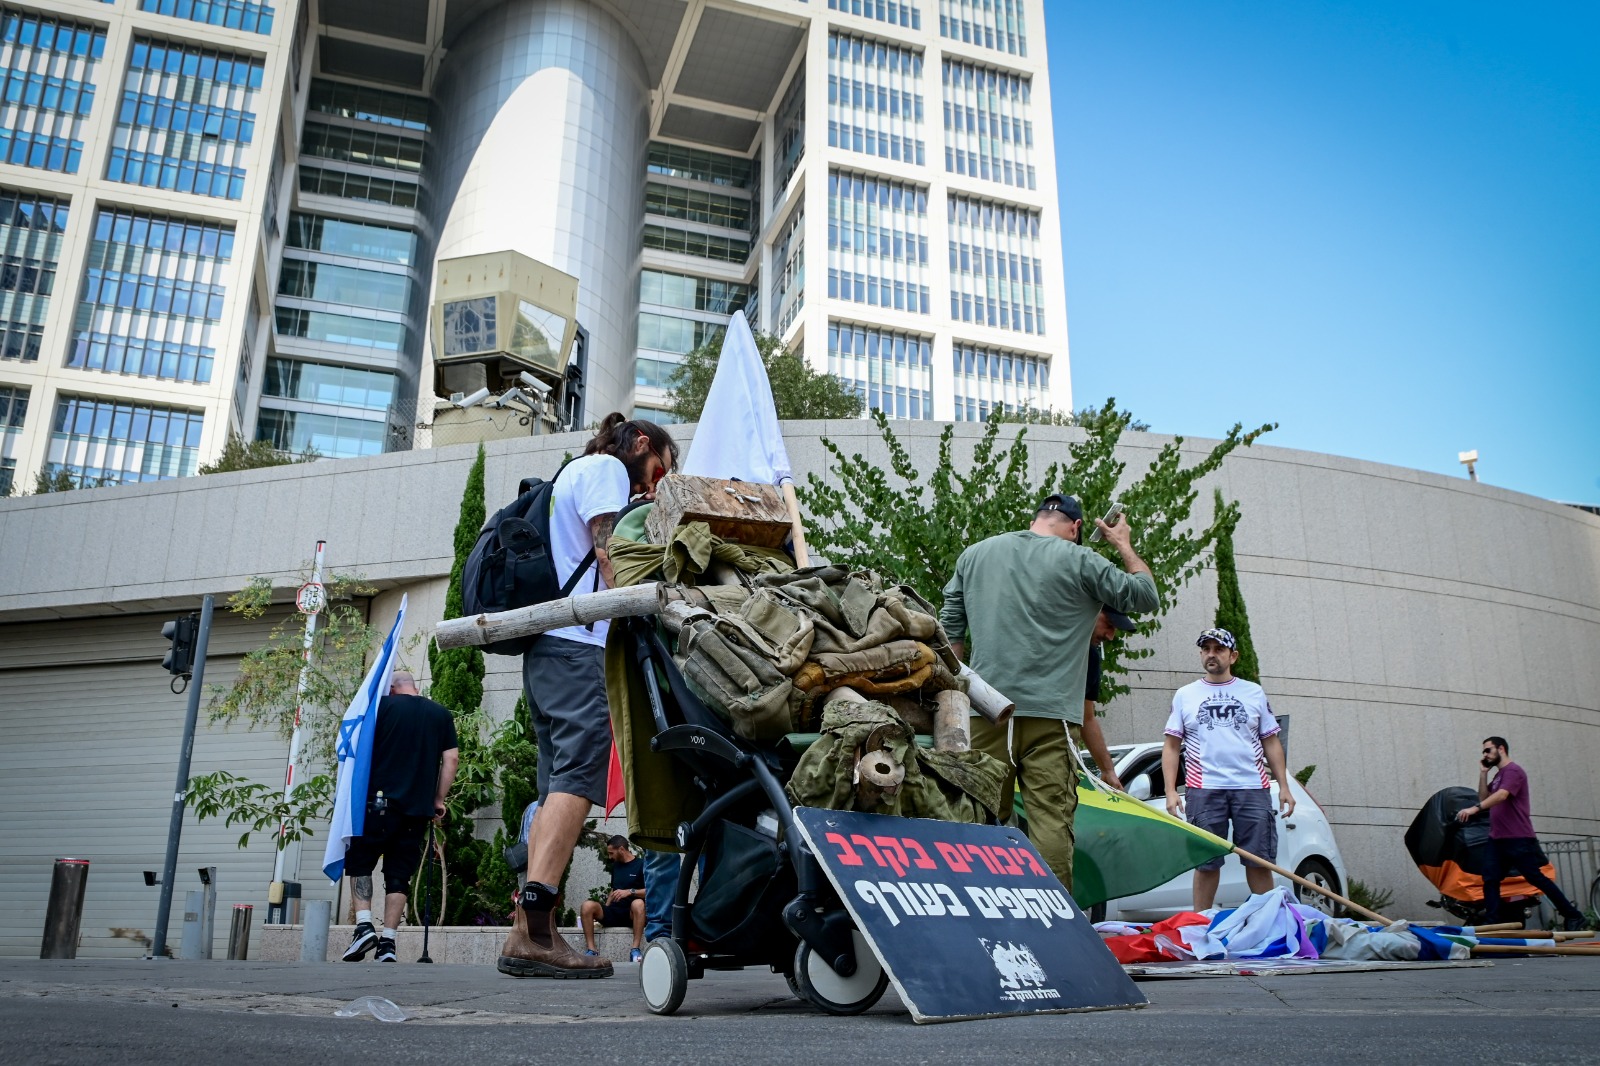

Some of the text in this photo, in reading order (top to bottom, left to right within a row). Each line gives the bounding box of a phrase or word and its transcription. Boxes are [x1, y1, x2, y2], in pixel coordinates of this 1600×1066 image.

[825, 832, 1047, 877] גיבורים בקרב
[854, 879, 1075, 929] שקופים בעורף
